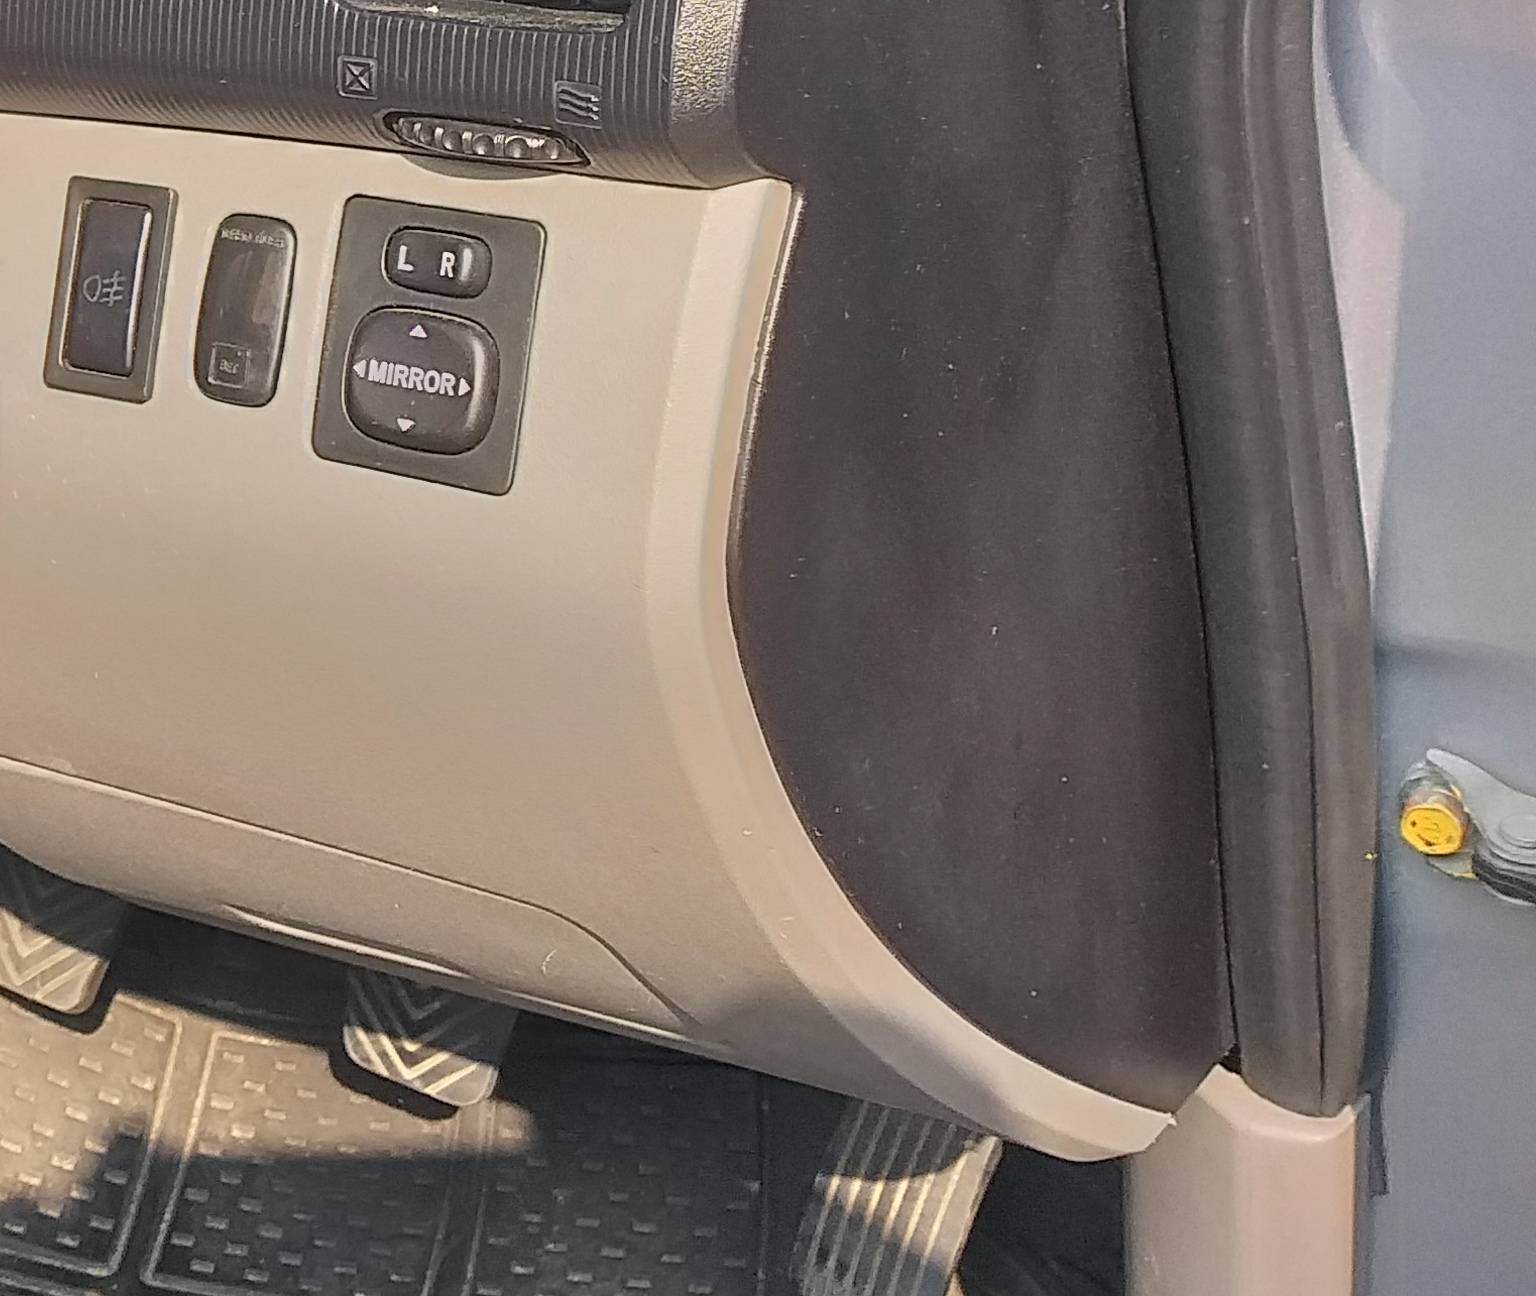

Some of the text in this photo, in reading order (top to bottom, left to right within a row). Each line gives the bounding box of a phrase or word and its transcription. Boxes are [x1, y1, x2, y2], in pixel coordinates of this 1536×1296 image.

[397, 245, 456, 278] L R
[368, 358, 456, 396] MIRROR
